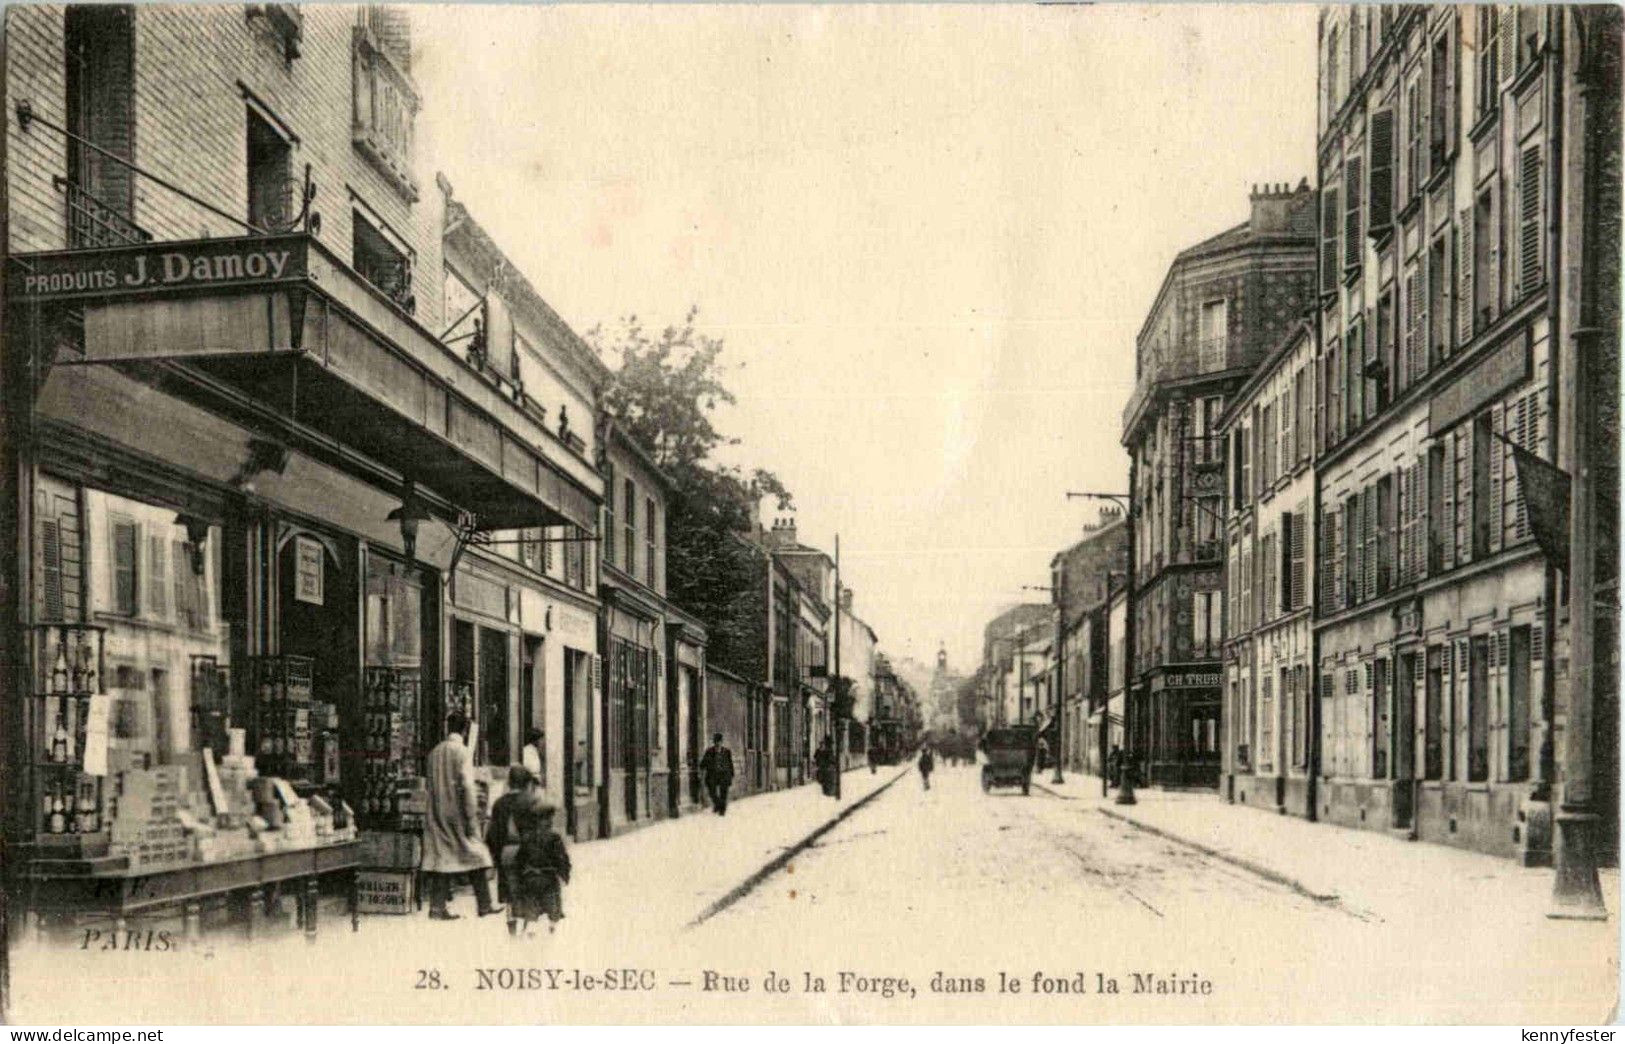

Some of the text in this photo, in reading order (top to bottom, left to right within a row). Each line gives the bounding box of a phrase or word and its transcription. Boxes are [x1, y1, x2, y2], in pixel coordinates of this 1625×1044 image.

[25, 250, 290, 294] PRODUITS J. Damoy
